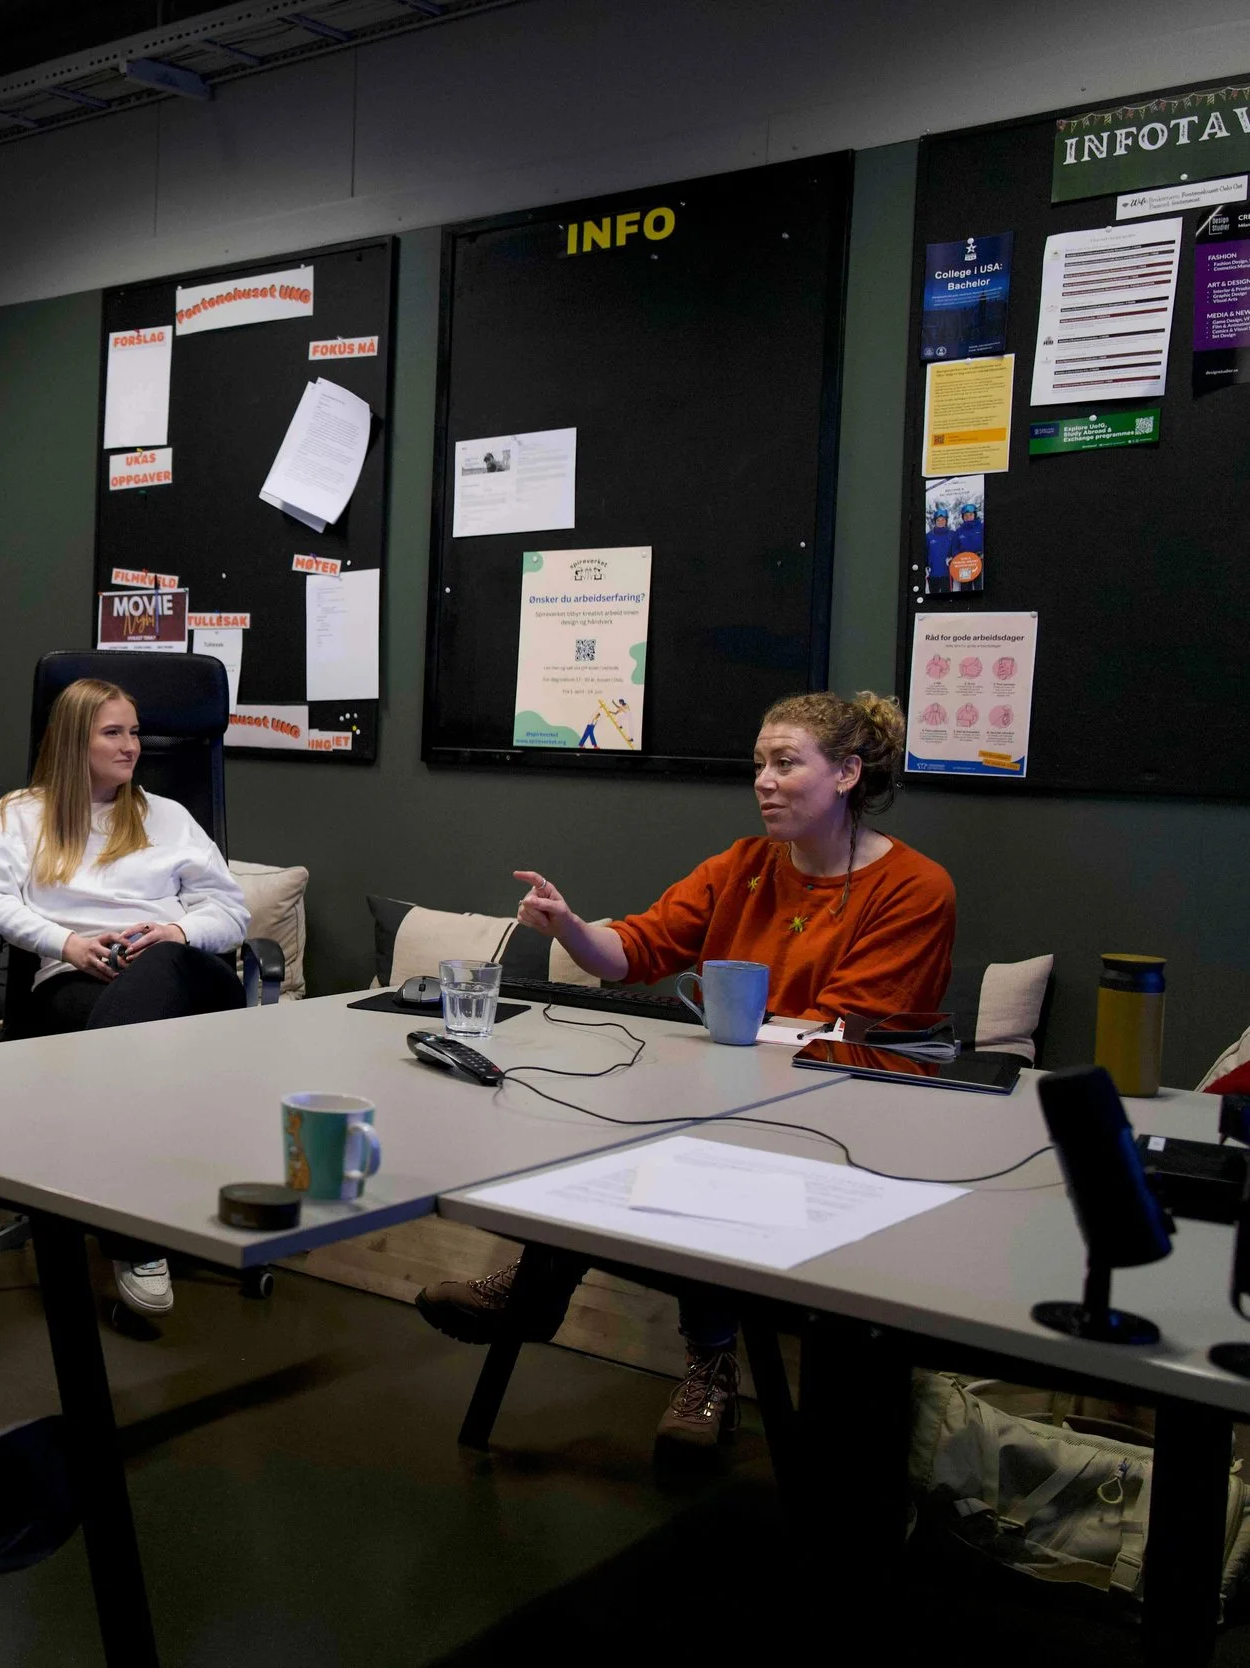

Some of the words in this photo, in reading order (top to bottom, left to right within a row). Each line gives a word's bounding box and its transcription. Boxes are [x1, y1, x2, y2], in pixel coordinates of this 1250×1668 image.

[566, 206, 676, 255] INFO
[1208, 253, 1237, 261] FASHION
[935, 268, 971, 279] College
[980, 262, 1003, 273] USA:
[947, 278, 991, 291] Bachelor
[279, 284, 311, 304] UNG
[1206, 311, 1228, 319] MEDIA
[113, 331, 165, 348] FORSLAG
[312, 341, 355, 356] FOKUS
[1063, 430, 1082, 438] Study
[1063, 434, 1094, 443] Exchange
[1095, 430, 1135, 440] programmes
[125, 453, 156, 467] UKAS
[111, 471, 171, 487] OPPGAVER
[295, 557, 338, 574] MØTER
[529, 595, 558, 604] Ønsker
[560, 594, 572, 603] du
[573, 592, 646, 604] arbeidserfaring?
[112, 594, 174, 617] MOVIE
[187, 615, 248, 627] TULLESAK
[972, 633, 1025, 643] arbeidsdager
[271, 718, 300, 739] UNG
